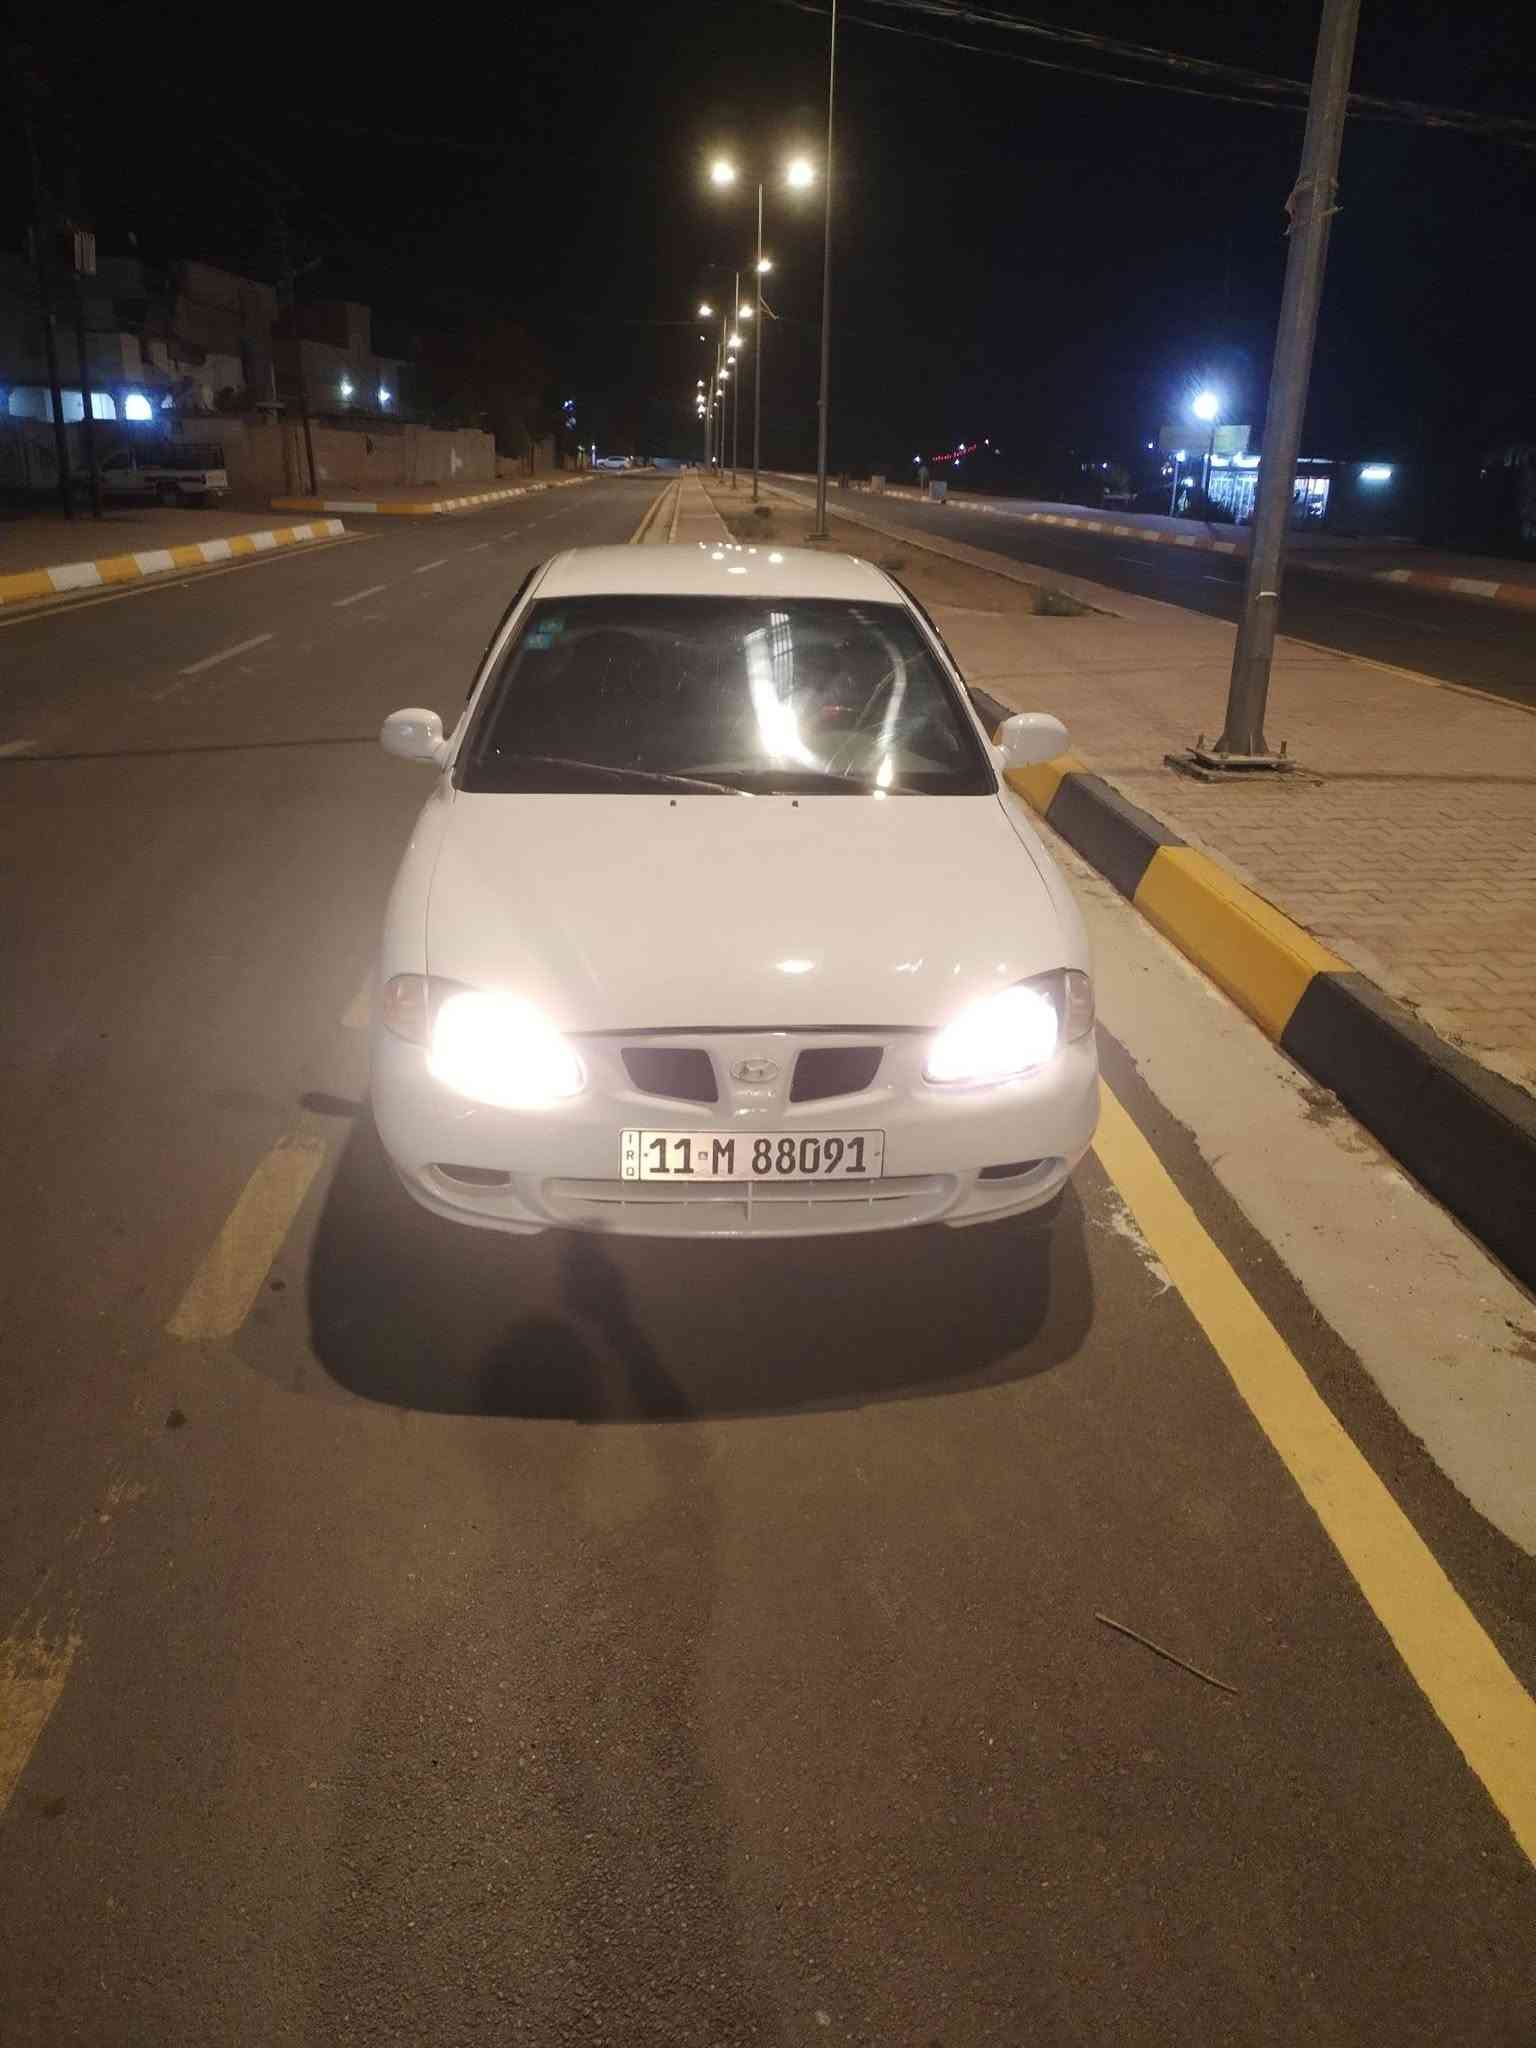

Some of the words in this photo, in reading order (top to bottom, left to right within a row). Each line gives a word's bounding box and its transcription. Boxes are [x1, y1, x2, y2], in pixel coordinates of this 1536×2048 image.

[626, 1134, 635, 1177] IRQ
[649, 1138, 694, 1174] 11
[712, 1139, 735, 1174] M
[751, 1137, 866, 1175] 88091
